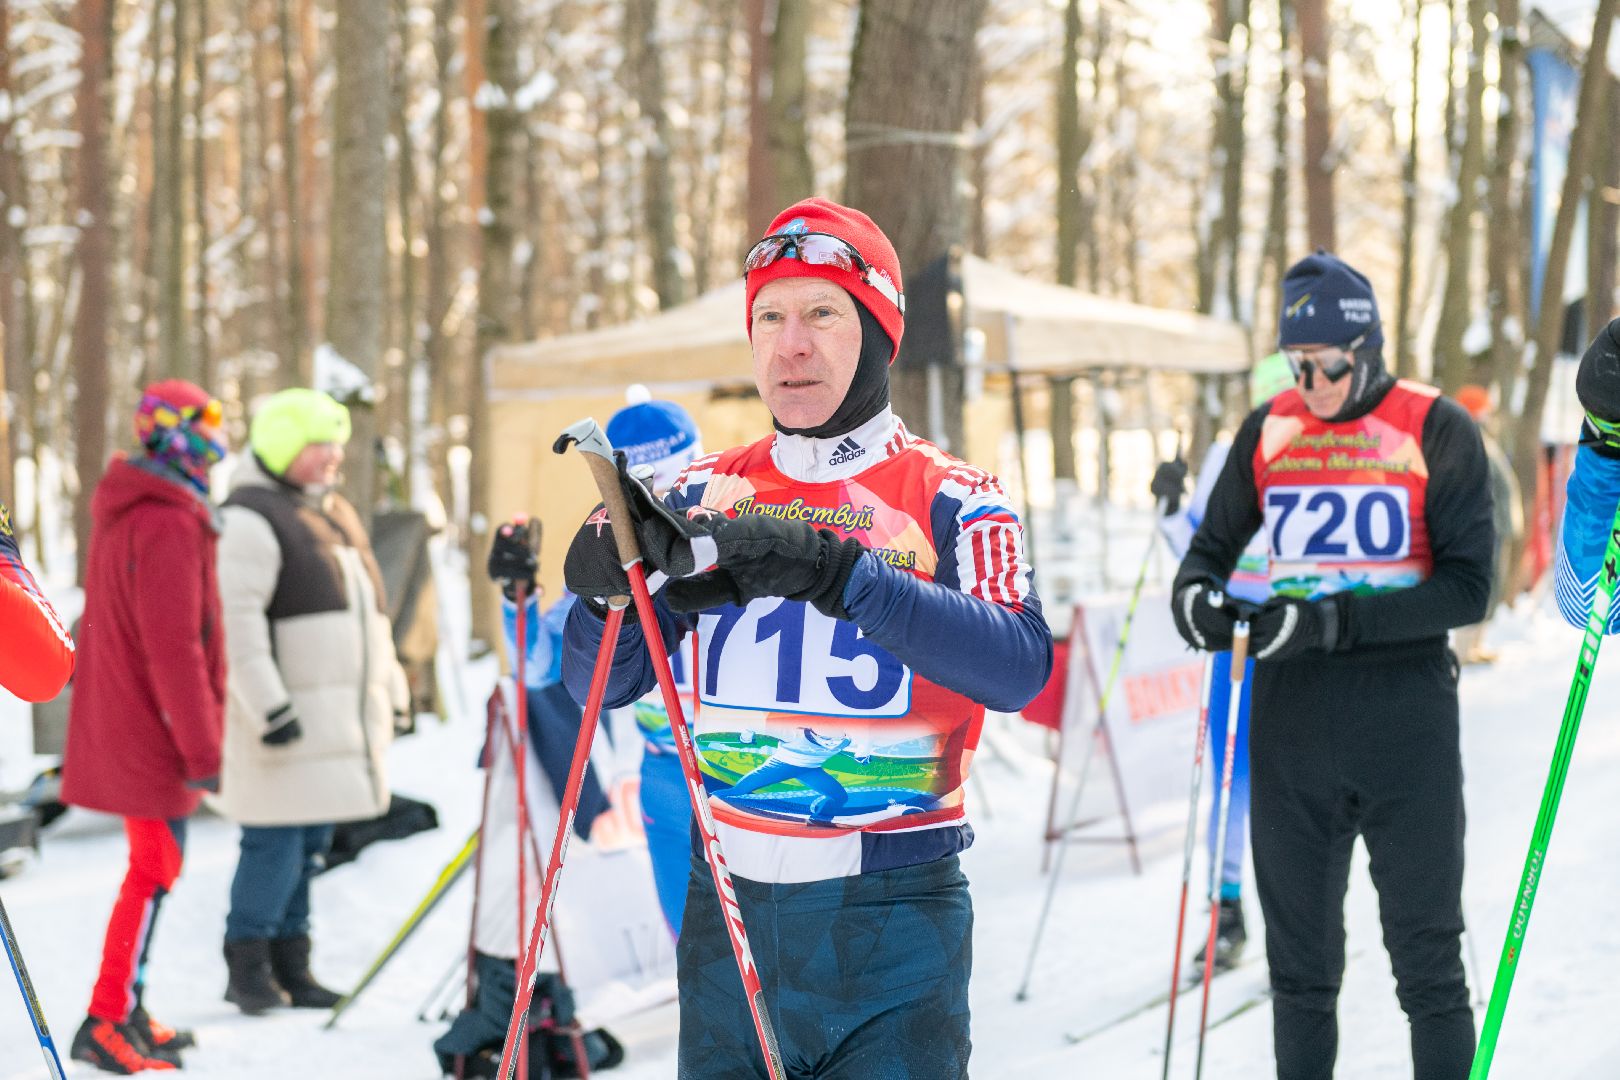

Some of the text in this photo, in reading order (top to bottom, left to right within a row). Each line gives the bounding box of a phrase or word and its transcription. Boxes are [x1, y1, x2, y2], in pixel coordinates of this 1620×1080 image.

[828, 447, 866, 466] adidas
[733, 496, 875, 533] Почувствуй
[1268, 491, 1405, 557] 720
[698, 600, 904, 710] 715
[1512, 849, 1543, 939] TORNADO
